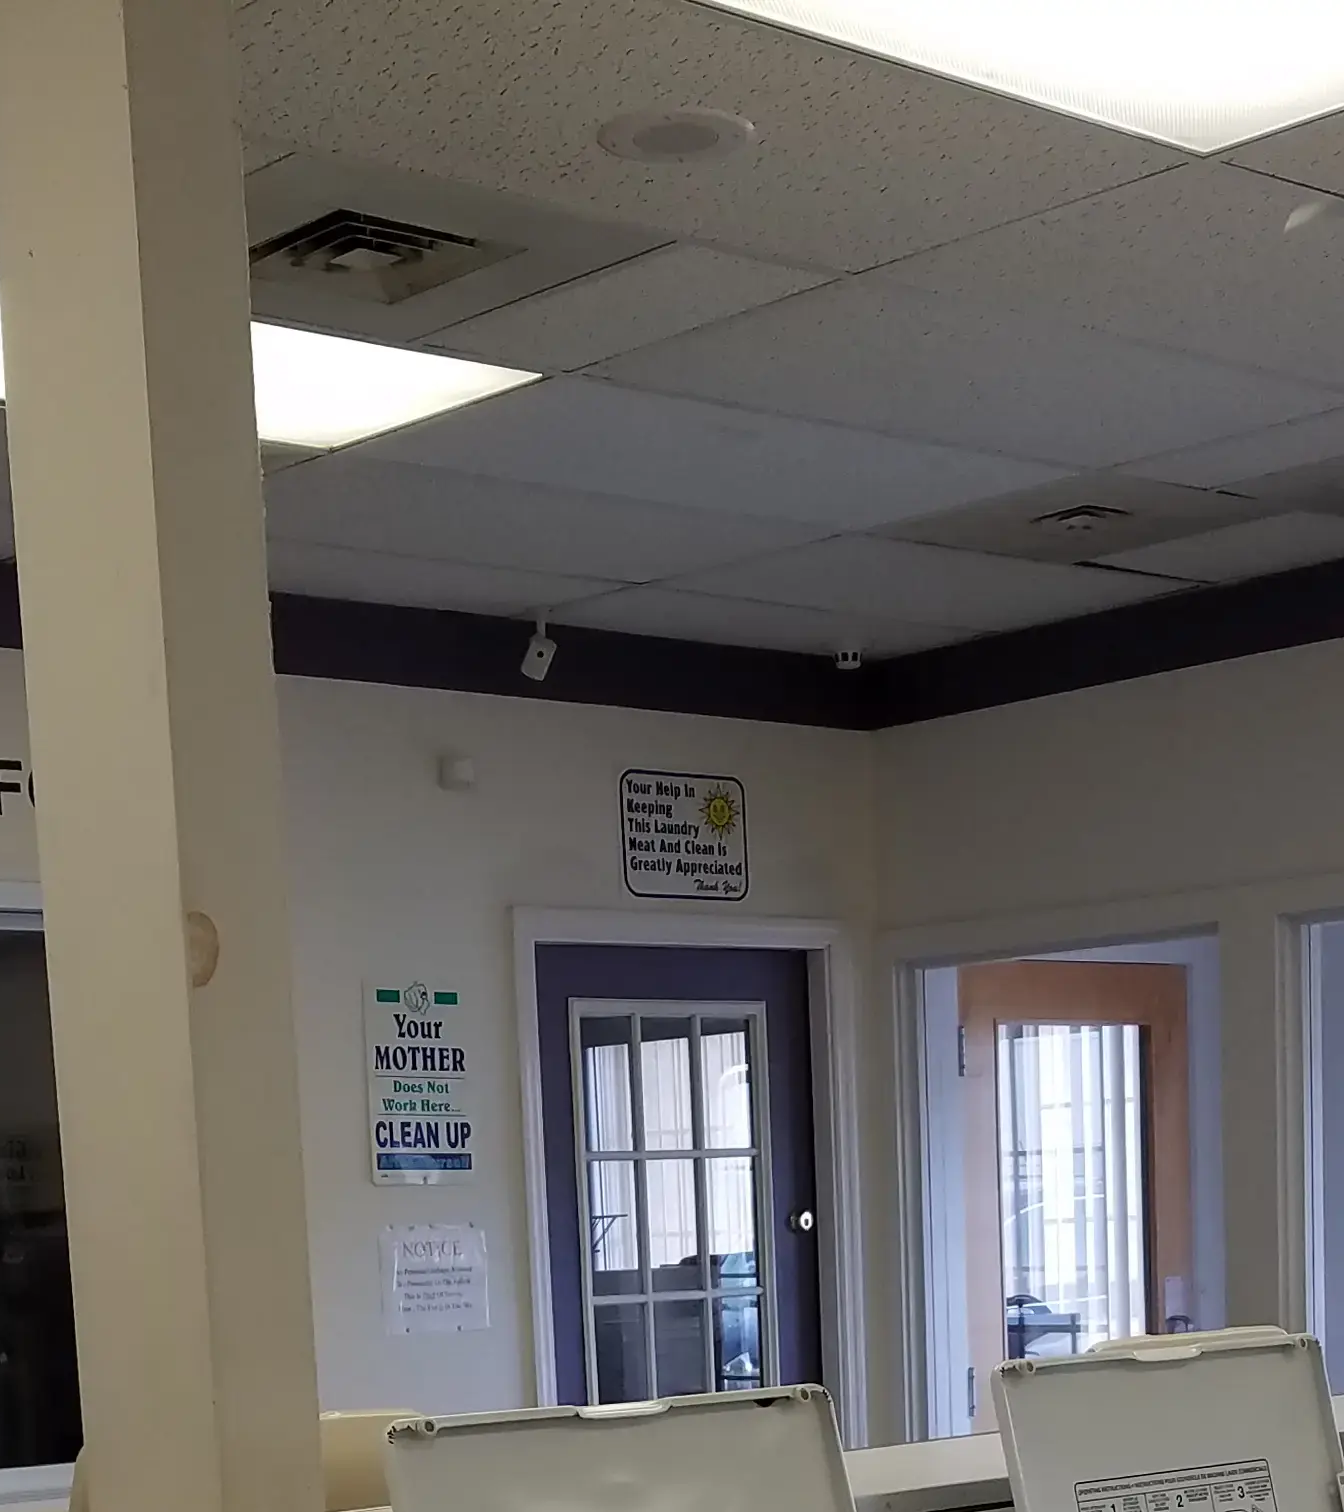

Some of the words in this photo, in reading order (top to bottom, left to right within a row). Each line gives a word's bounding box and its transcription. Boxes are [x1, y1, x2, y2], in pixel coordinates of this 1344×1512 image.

[626, 778, 653, 795] Your
[656, 781, 681, 800] Help
[684, 783, 696, 798] In
[627, 798, 673, 818] Keeping
[628, 818, 651, 833] This
[654, 820, 700, 838] Laundry
[629, 837, 656, 852] Neat
[659, 839, 681, 854] And
[685, 840, 715, 856] Clean
[718, 842, 727, 857] Is
[630, 856, 672, 876] Greatly
[676, 858, 742, 876] Appreciated
[694, 879, 718, 892] Thank
[393, 1014, 443, 1039] Your
[374, 1045, 466, 1072] MOTHER
[393, 1080, 424, 1094] Does
[427, 1081, 450, 1094] Not
[382, 1098, 418, 1112] Work
[375, 1121, 440, 1149] CLEAN
[446, 1122, 471, 1149] UP
[1176, 1495, 1185, 1508] 2
[1237, 1486, 1246, 1499] 3
